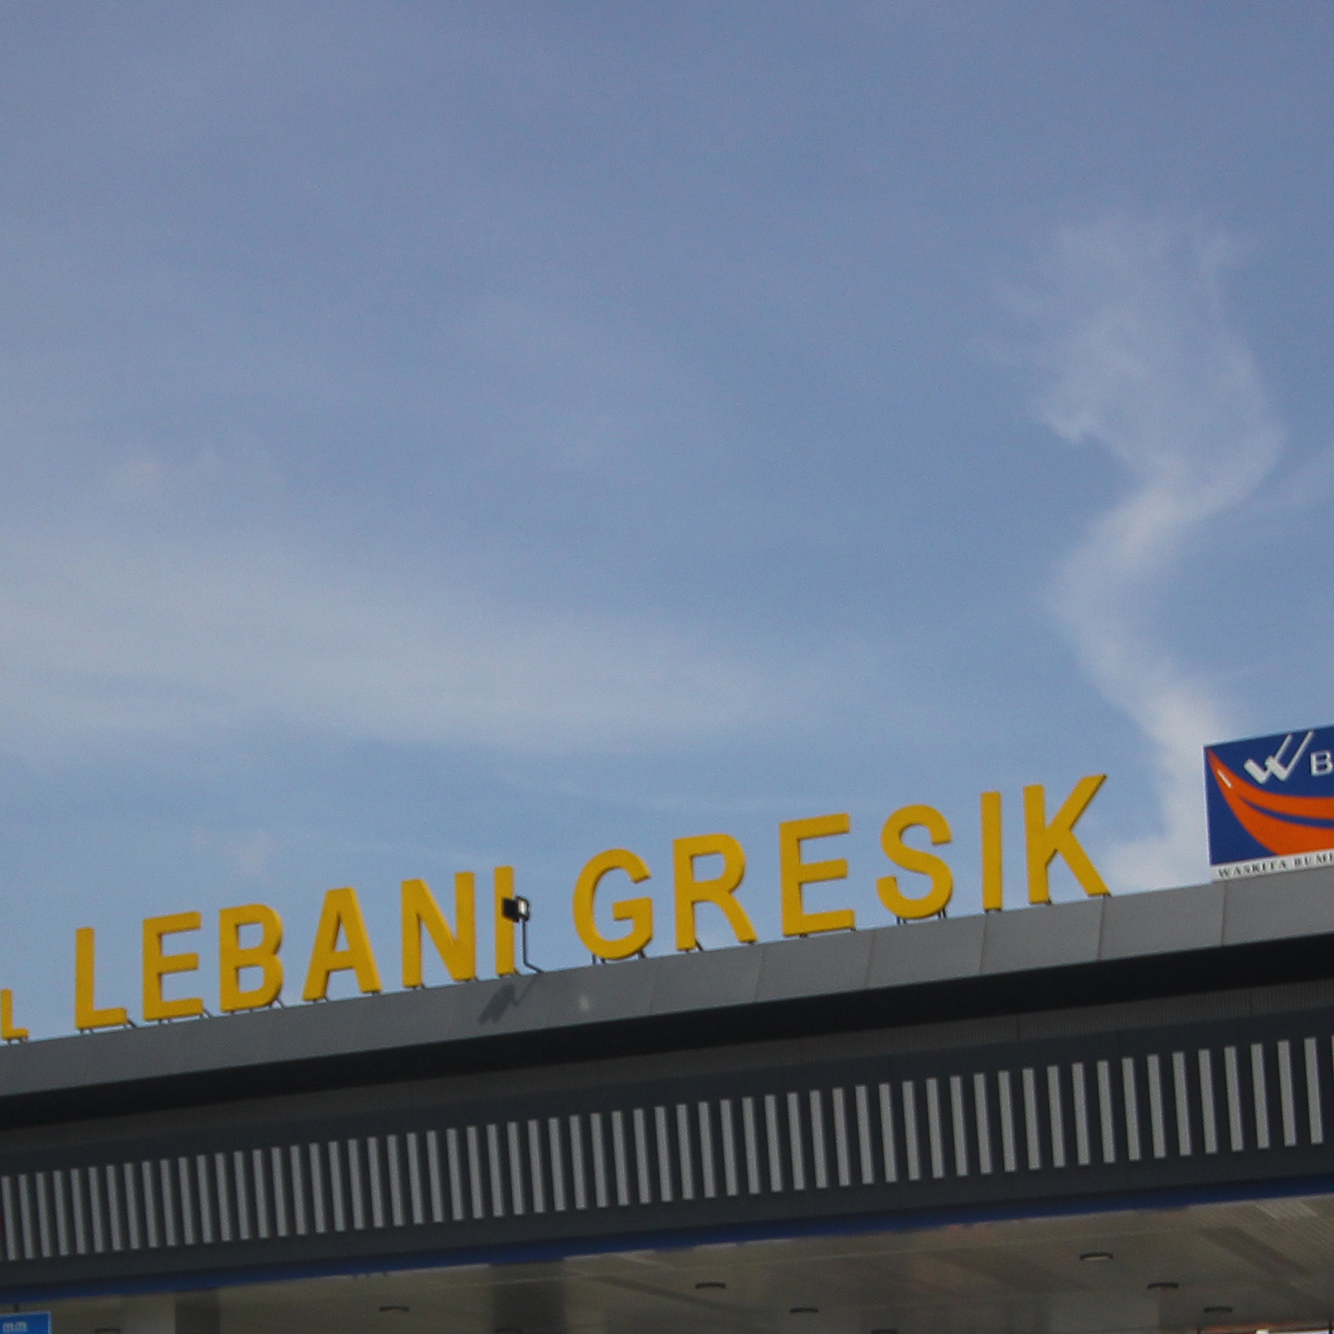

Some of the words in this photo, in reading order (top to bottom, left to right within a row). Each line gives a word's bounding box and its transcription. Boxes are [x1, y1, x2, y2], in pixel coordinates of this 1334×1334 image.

[1293, 853, 1333, 867] BUMI
[73, 865, 516, 1030] LEBANI
[572, 774, 1110, 962] GRESIK
[2, 1320, 28, 1334] mm
